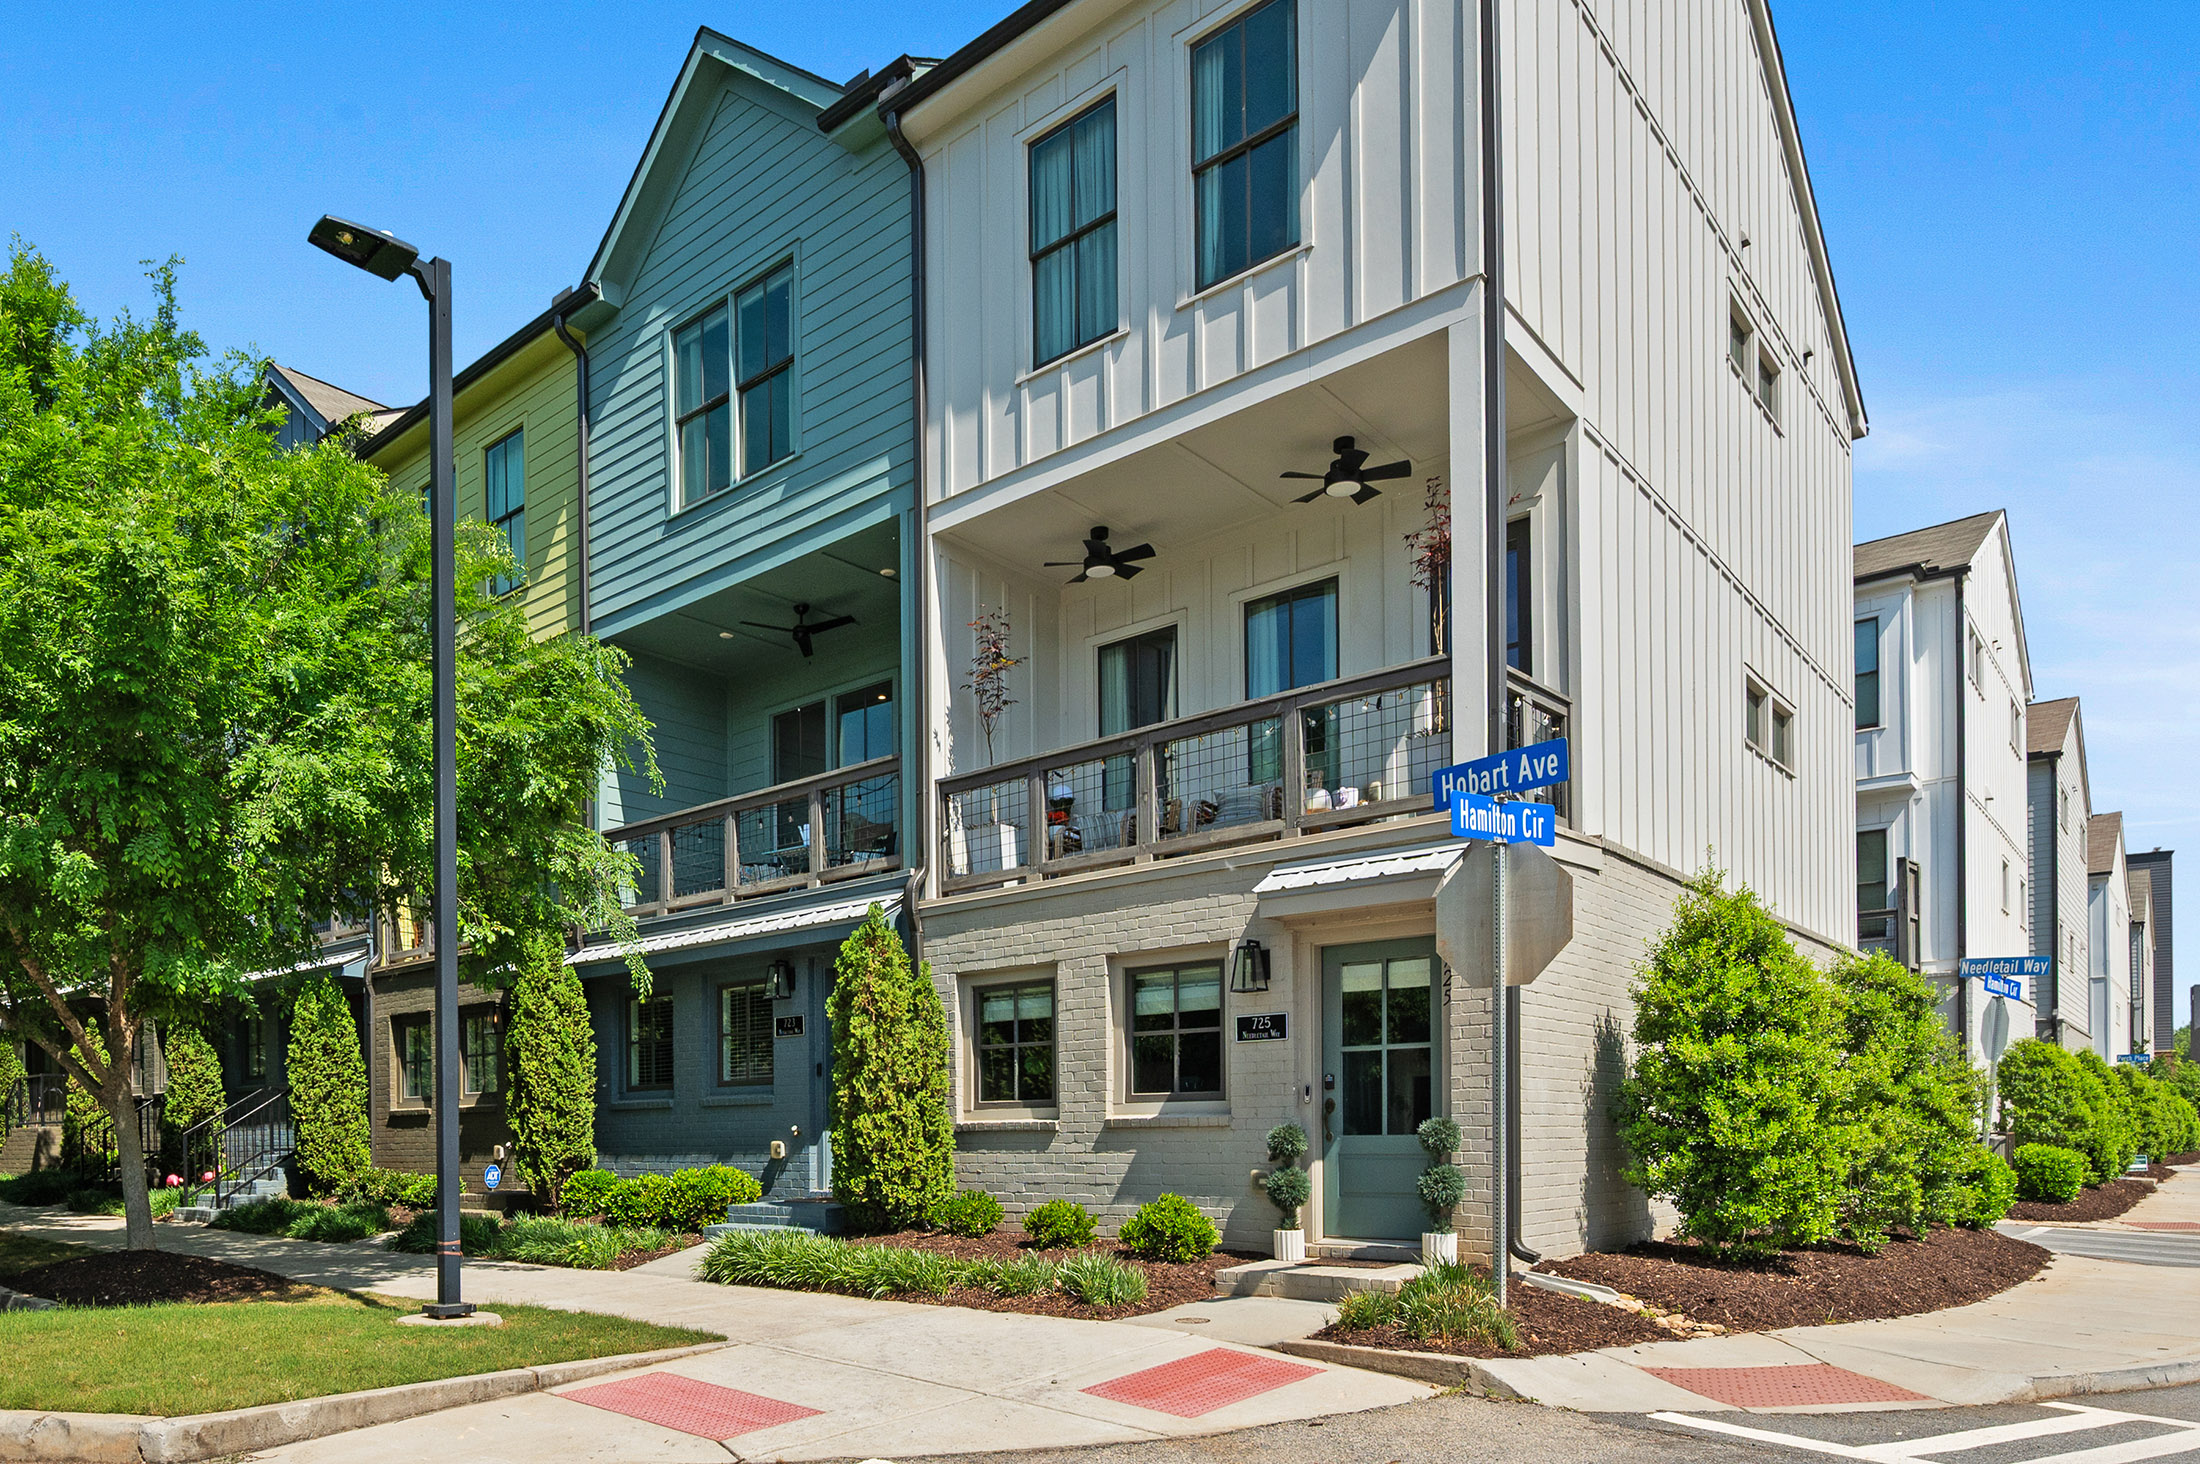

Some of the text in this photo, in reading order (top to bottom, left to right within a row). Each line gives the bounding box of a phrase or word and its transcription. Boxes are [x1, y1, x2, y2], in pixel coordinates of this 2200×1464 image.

[1441, 753, 1558, 802] Hobart Ave
[1460, 798, 1544, 839] Hamilton Cir
[1961, 959, 2048, 975] Needletail Way
[1252, 1016, 1271, 1029] 725
[487, 1171, 499, 1180] ADT
